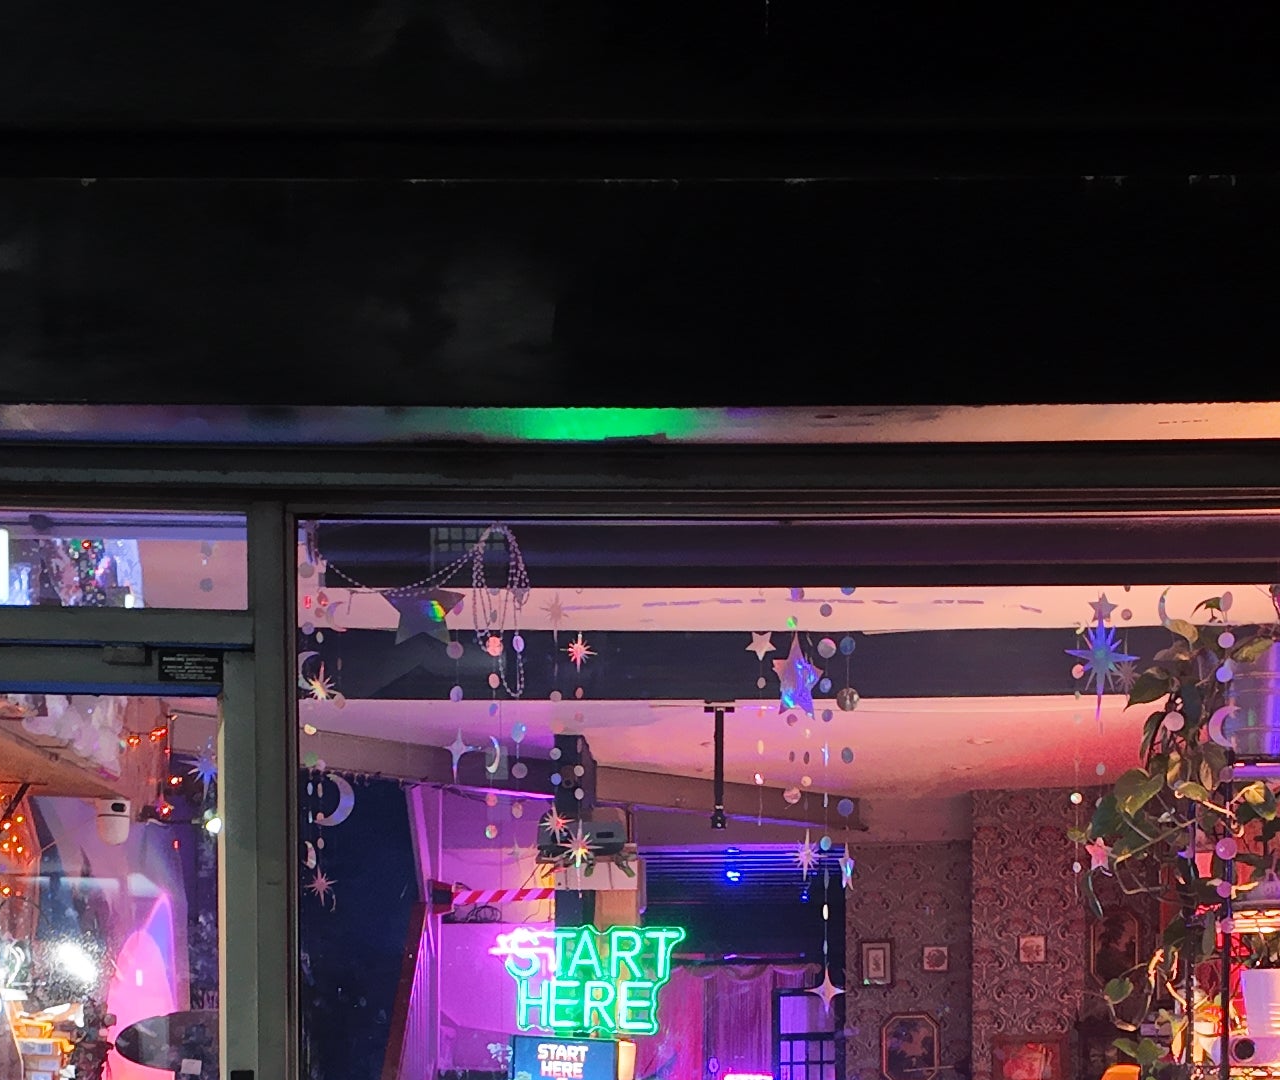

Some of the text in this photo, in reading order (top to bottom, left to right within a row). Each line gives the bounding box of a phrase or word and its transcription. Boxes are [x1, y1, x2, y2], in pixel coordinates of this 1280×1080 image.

[505, 929, 681, 978] START
[519, 979, 654, 1030] HERE
[538, 1043, 589, 1062] START
[541, 1060, 584, 1079] HERE
